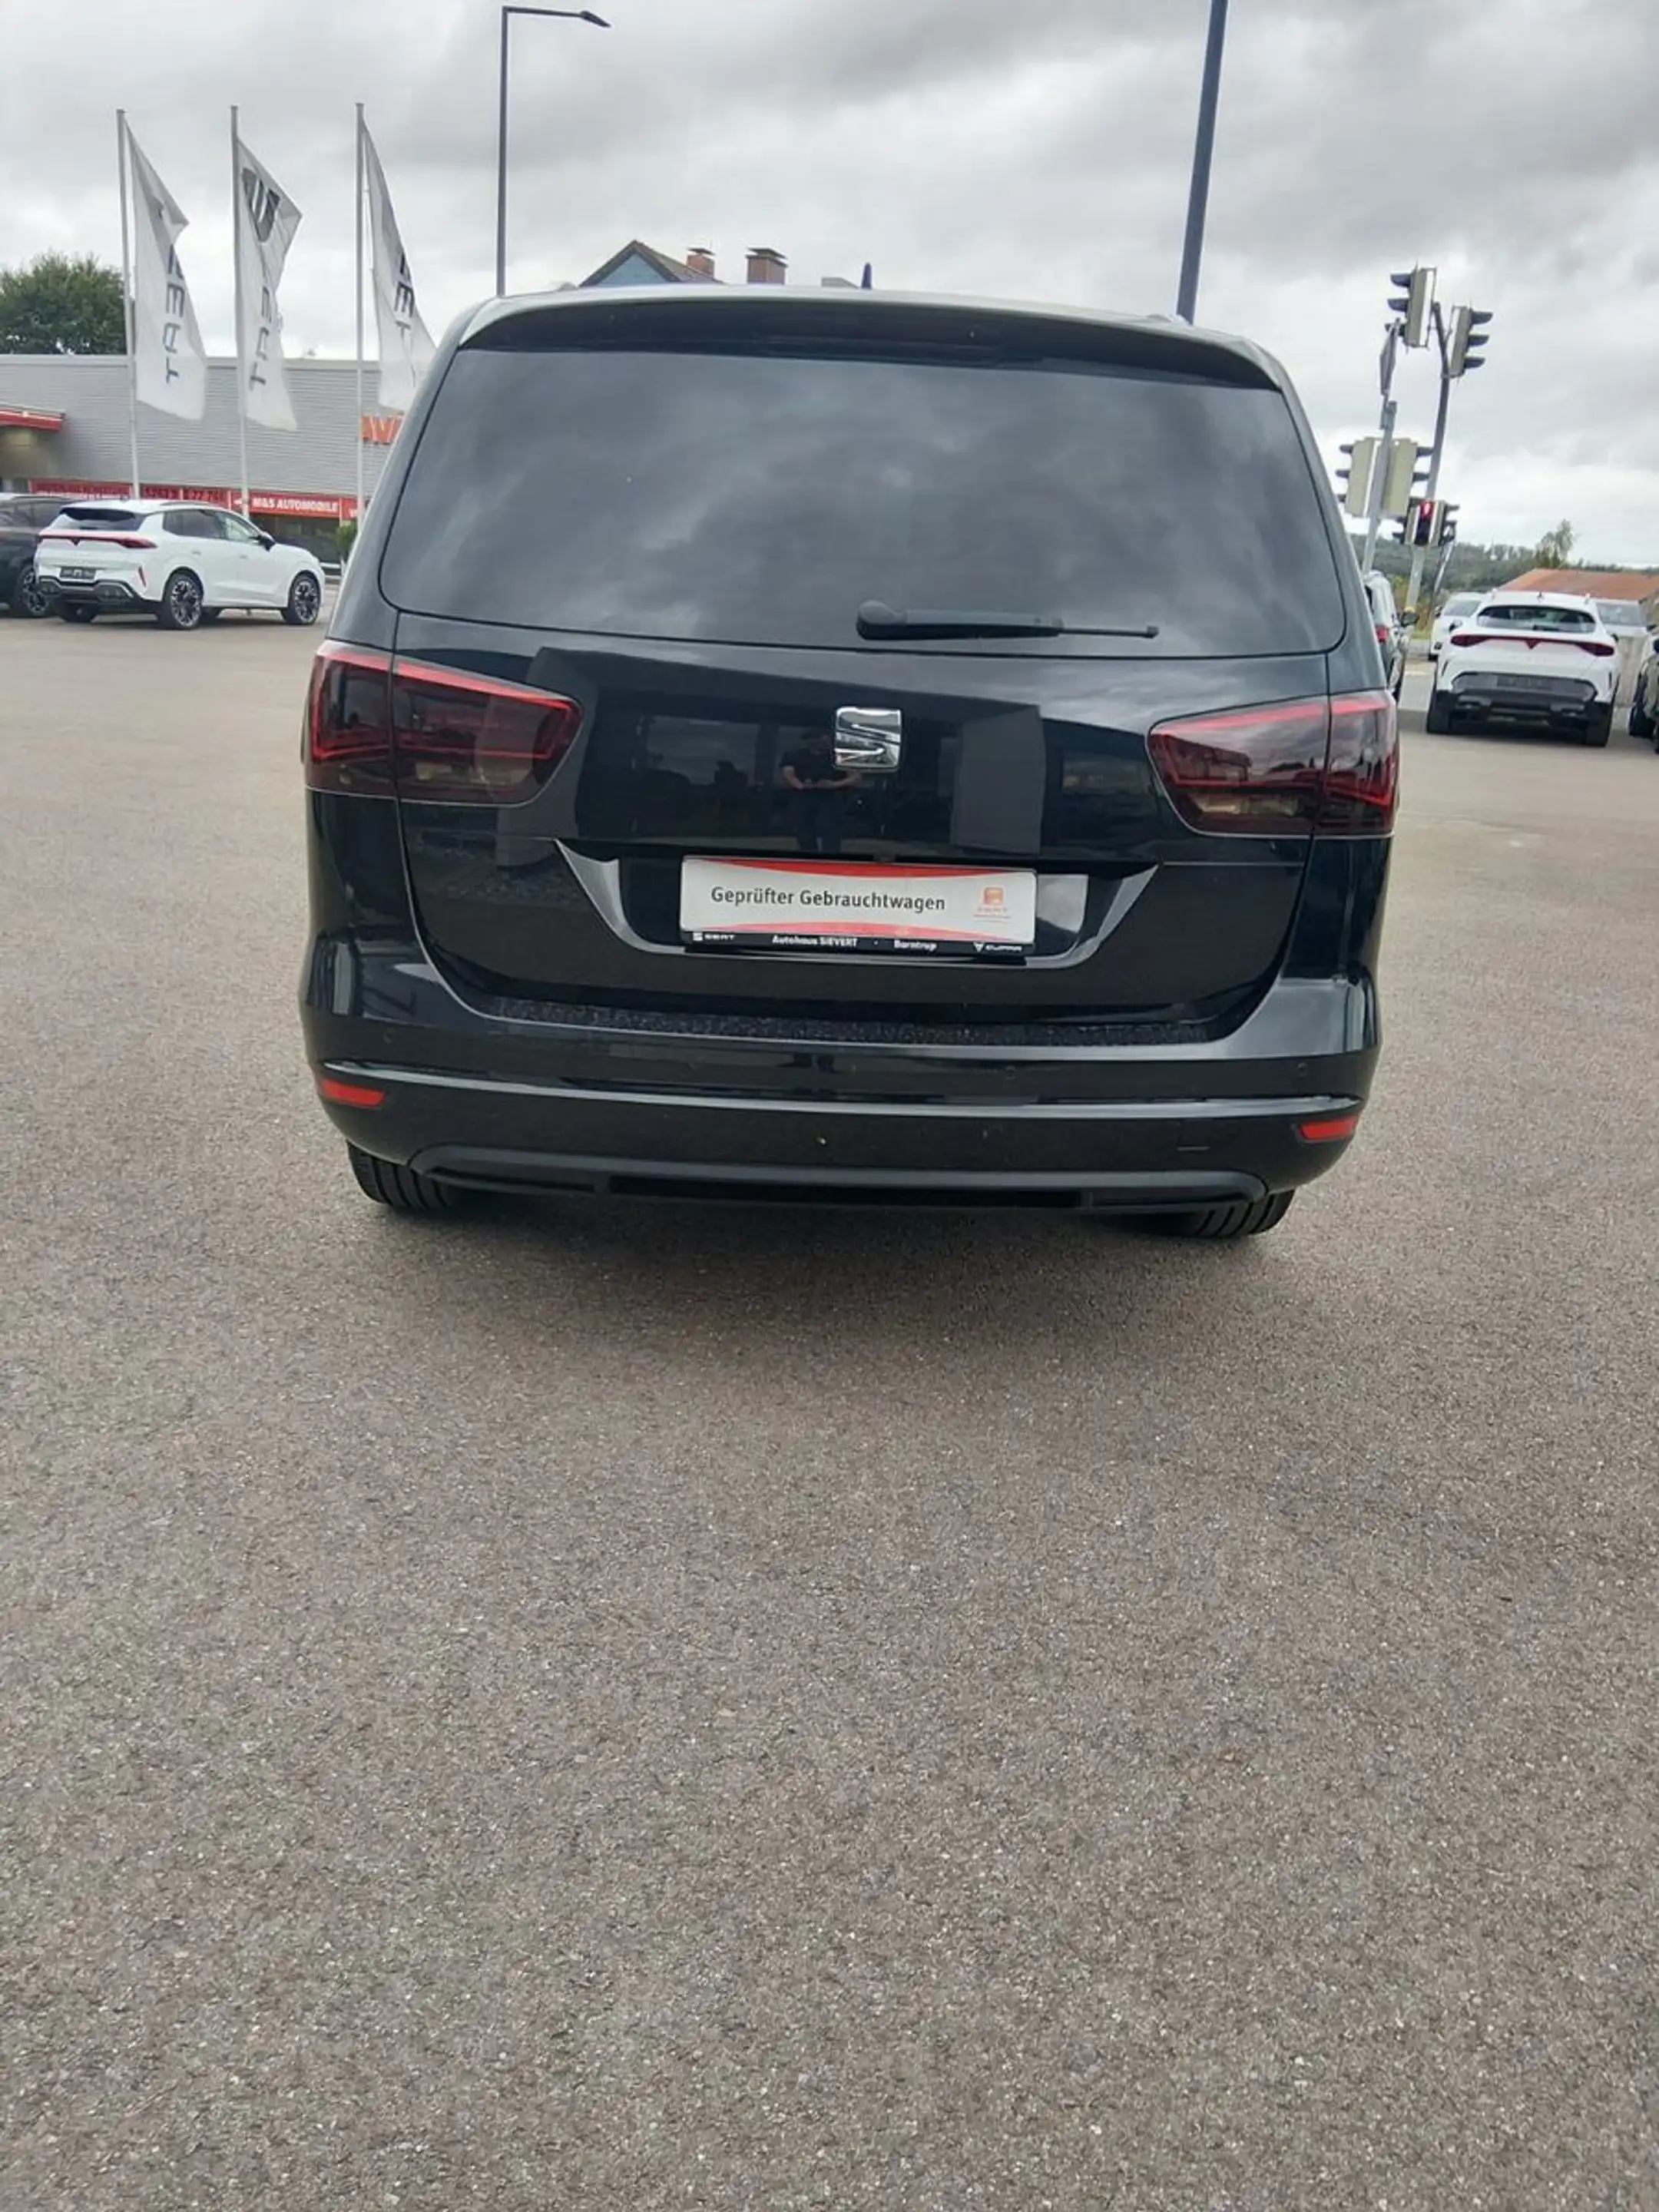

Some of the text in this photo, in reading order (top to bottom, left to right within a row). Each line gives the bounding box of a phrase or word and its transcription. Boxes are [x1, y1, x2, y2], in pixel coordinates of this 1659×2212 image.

[276, 498, 339, 513] AUTOMOBILE
[711, 886, 945, 913] Geprüfter Gebrauchtwagen
[772, 935, 817, 945] Autohaus
